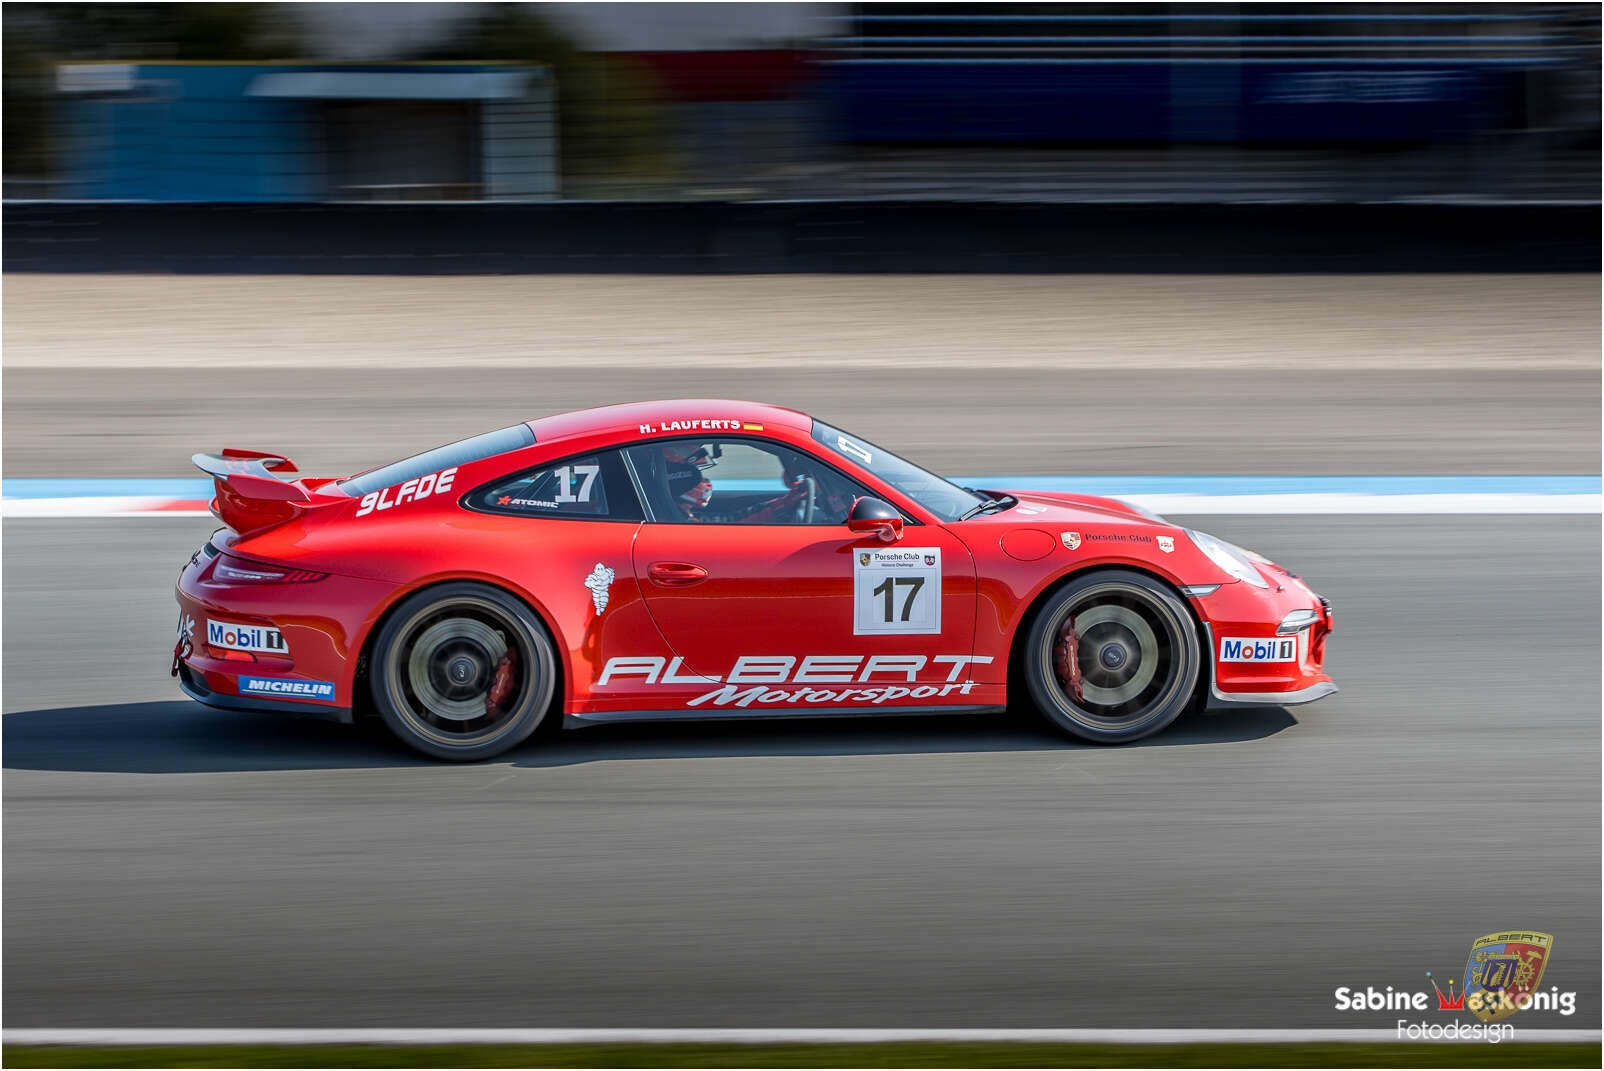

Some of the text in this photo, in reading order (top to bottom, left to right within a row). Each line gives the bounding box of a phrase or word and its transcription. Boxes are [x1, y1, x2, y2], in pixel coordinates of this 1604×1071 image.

[639, 419, 741, 434] H. LAUFERTS
[554, 465, 600, 503] 17
[510, 498, 559, 509] ATOMIC
[873, 577, 925, 622] 17
[210, 623, 261, 648] Mobil
[266, 630, 284, 650] 1
[1224, 640, 1293, 660] Mobil 1
[598, 656, 994, 685] ALBERT
[248, 680, 332, 695] MICHELIN
[686, 681, 981, 707] Motorsport
